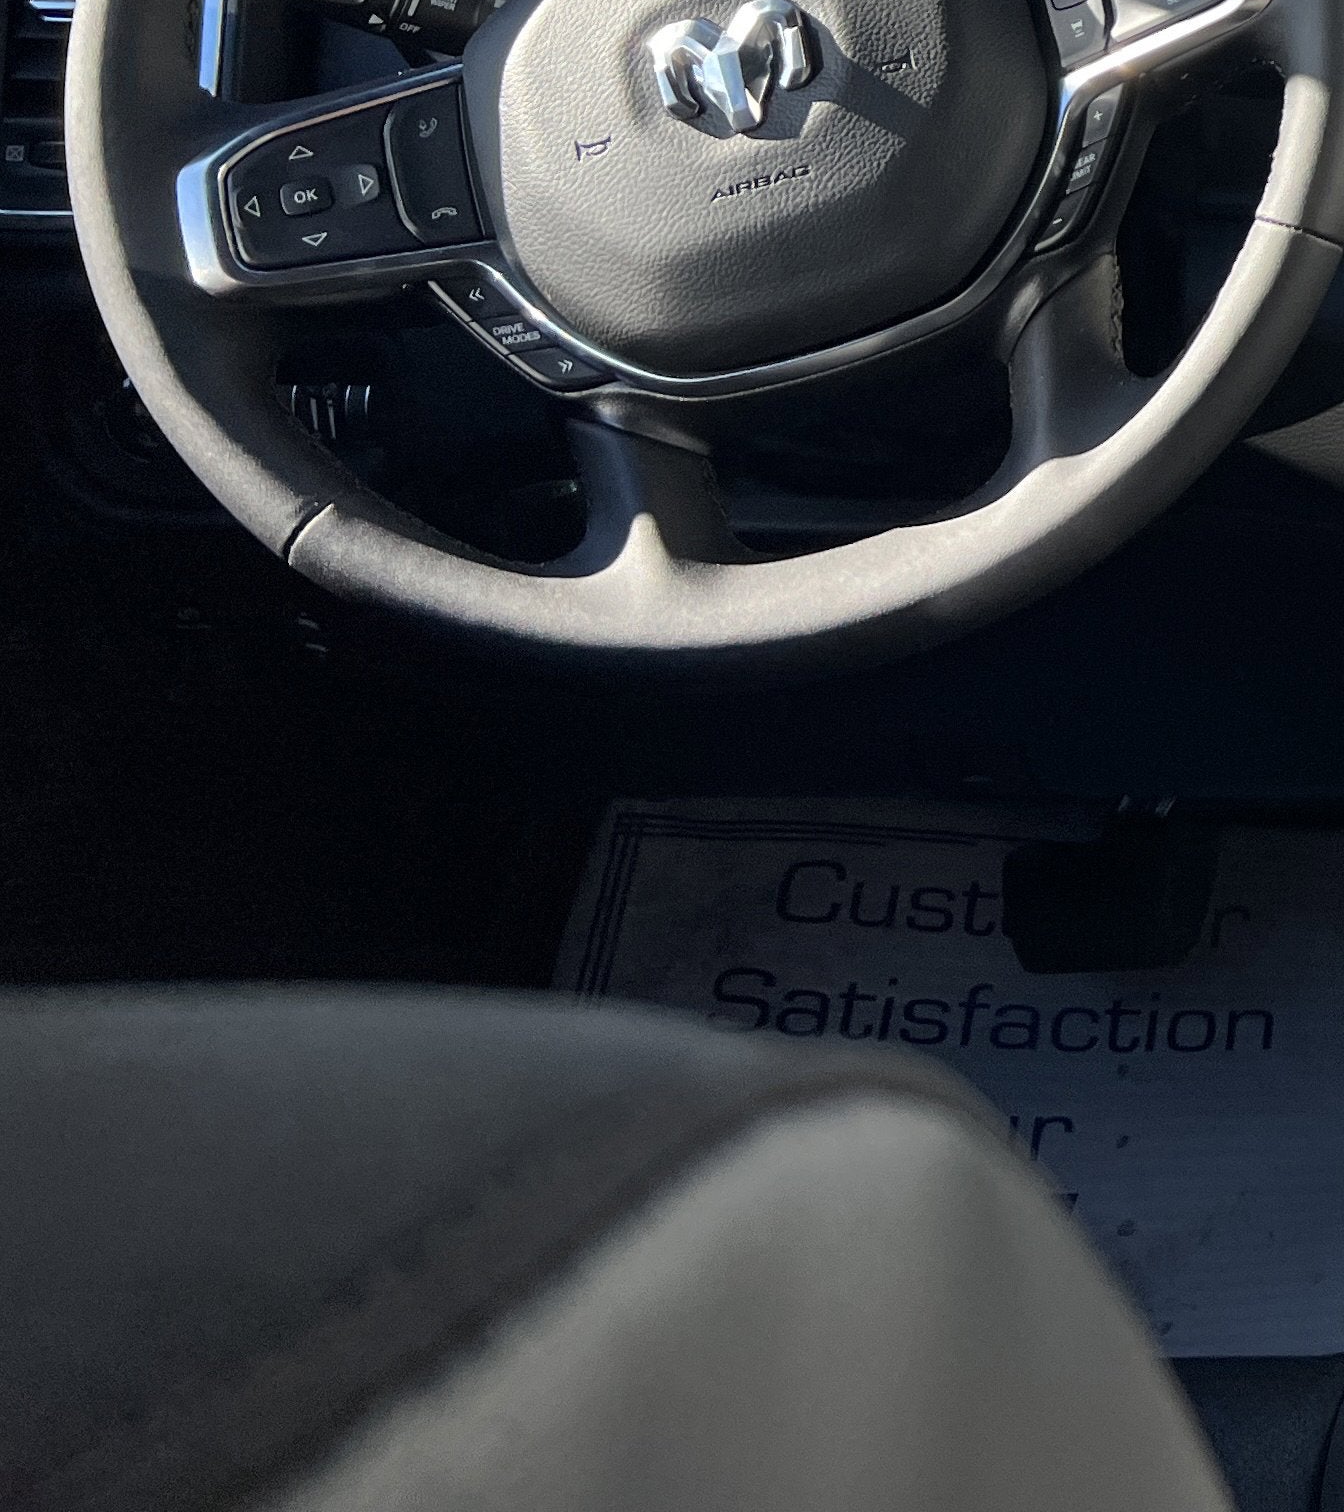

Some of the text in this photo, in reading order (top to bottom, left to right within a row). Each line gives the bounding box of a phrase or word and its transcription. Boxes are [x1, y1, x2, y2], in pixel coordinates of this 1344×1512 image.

[399, 22, 421, 33] OFF
[710, 164, 812, 203] AIRBAG
[293, 188, 319, 205] OK
[493, 322, 524, 336] DRIVE
[502, 330, 541, 345] MODES
[775, 859, 1251, 950] Custr
[707, 967, 1276, 1054] Satisfaction
